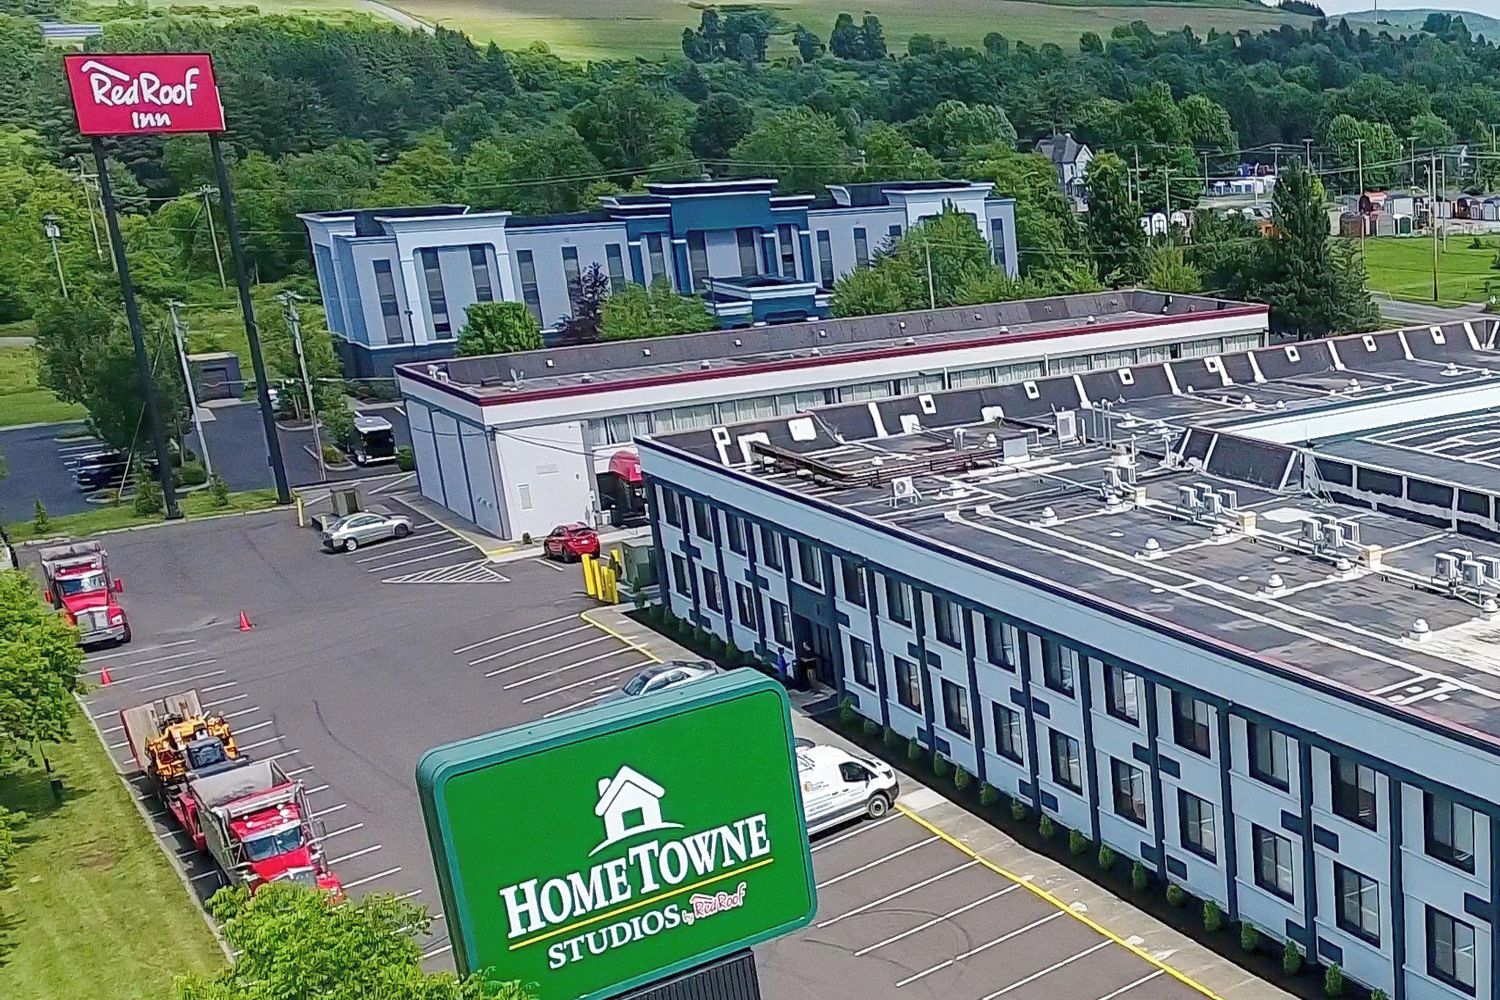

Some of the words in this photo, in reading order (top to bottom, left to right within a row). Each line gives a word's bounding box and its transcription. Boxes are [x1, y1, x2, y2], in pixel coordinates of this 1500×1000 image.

[131, 111, 172, 129] Inn
[548, 904, 681, 969] STUDIOS
[682, 910, 695, 925] by
